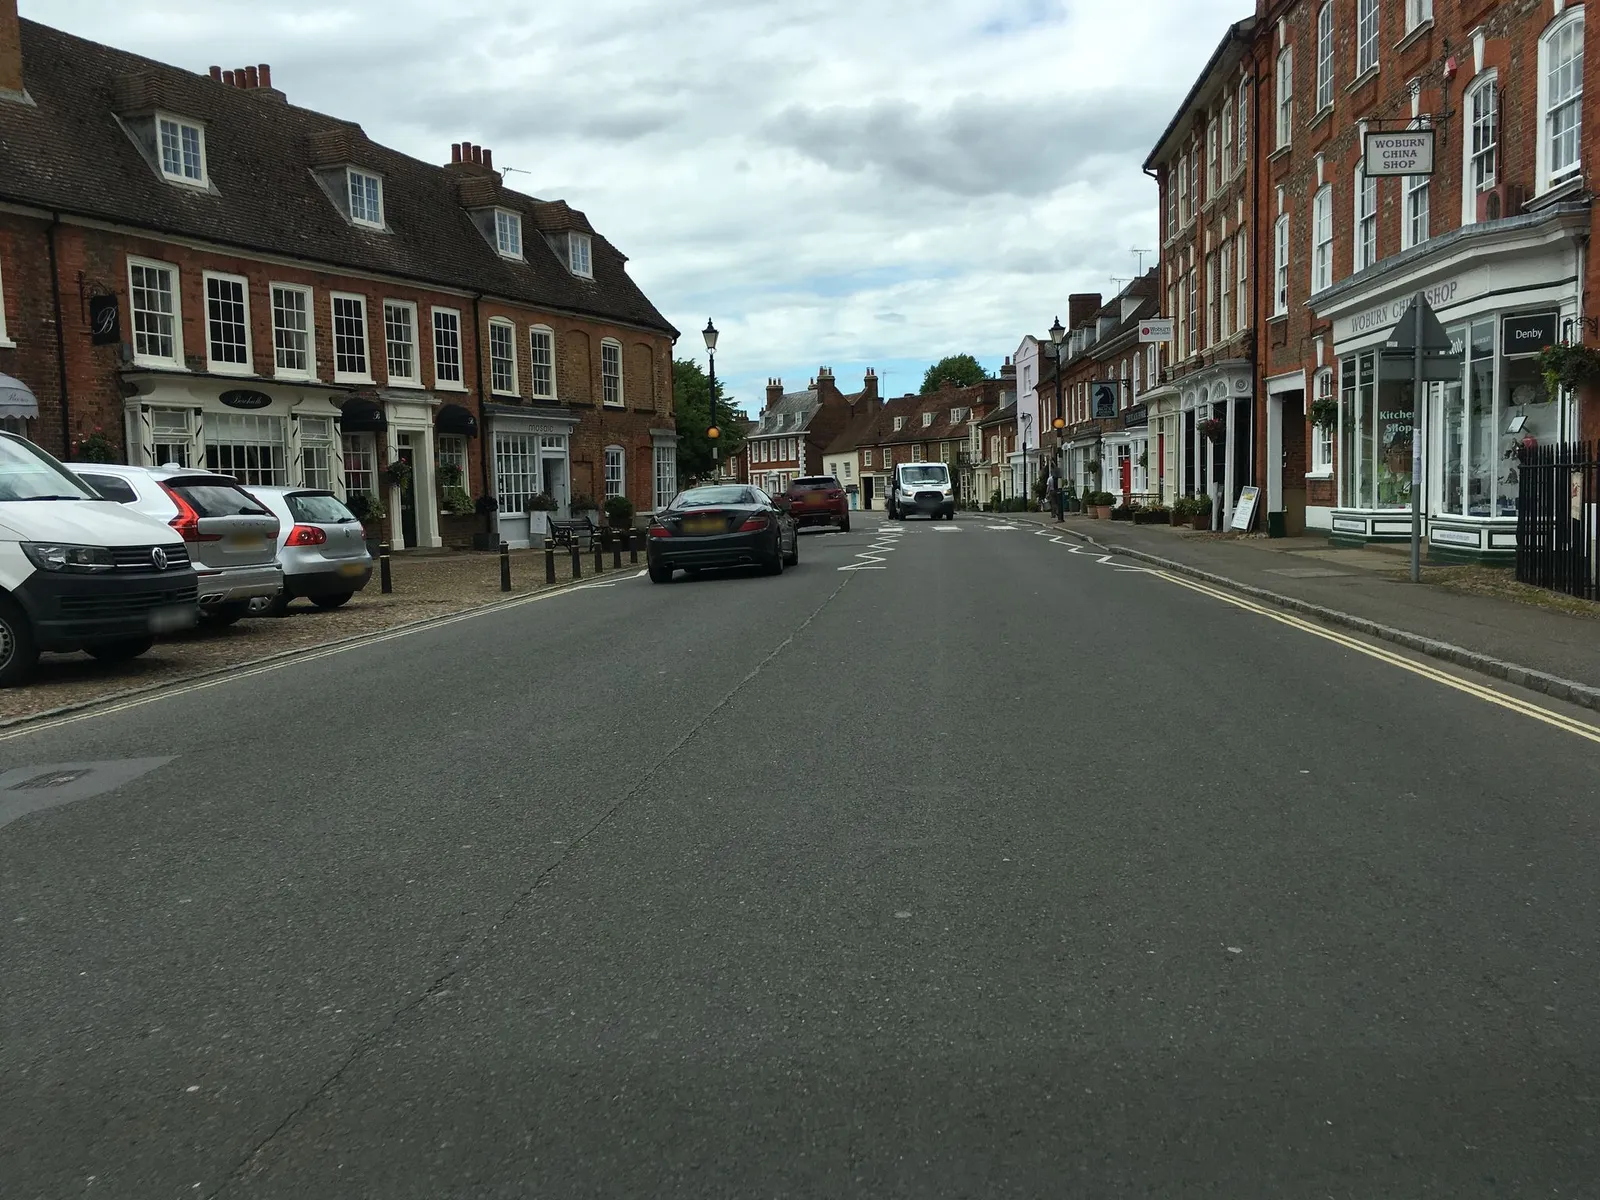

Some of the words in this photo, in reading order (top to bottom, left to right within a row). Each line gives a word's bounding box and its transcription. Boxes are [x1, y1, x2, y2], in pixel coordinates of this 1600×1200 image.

[1374, 138, 1425, 148] WOBURN
[1382, 149, 1418, 159] CHINA
[1383, 160, 1416, 169] SHOP
[1351, 306, 1388, 332] WOBURN
[1427, 281, 1457, 306] SHOP
[1515, 328, 1543, 339] Denby
[1386, 423, 1412, 434] Shop
